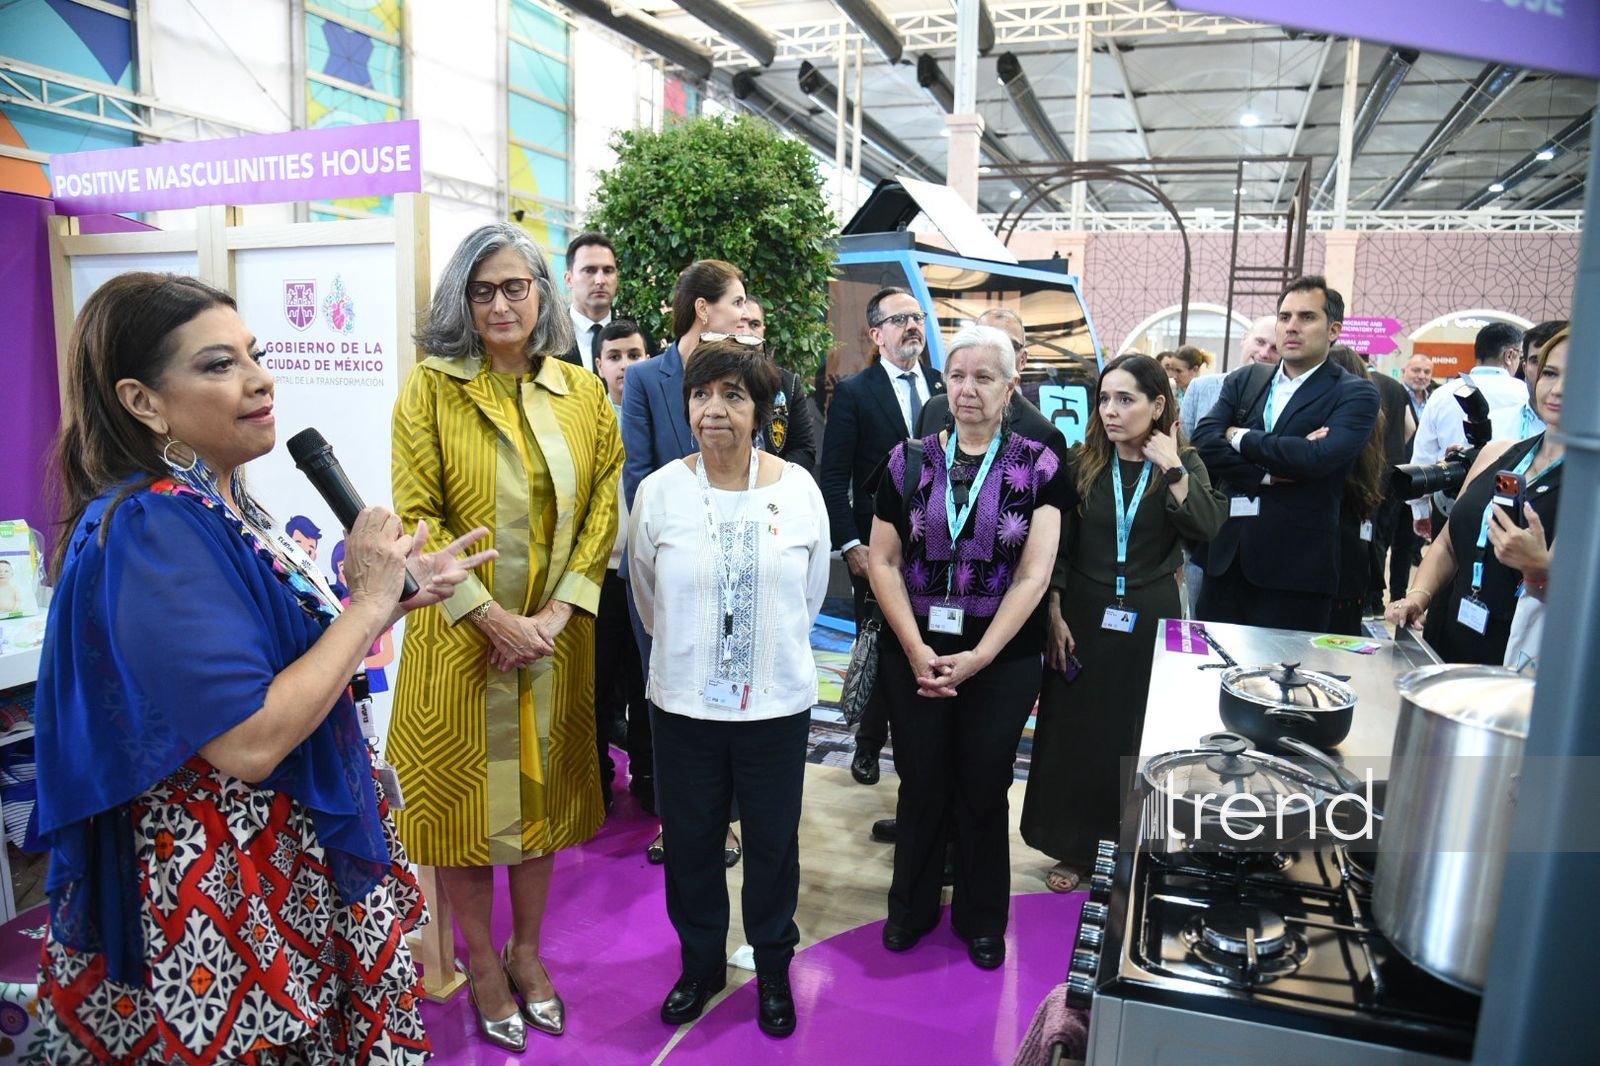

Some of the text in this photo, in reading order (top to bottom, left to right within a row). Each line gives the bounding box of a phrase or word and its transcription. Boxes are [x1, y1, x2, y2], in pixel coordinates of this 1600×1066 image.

[55, 144, 412, 198] POSITIVE MASCULINITIES HOUSE
[266, 341, 383, 355] GOBIERNO DE LA
[266, 356, 384, 372] CIUDAD DE MÉXICO
[274, 376, 294, 385] PITAL
[361, 702, 369, 723] WUF13
